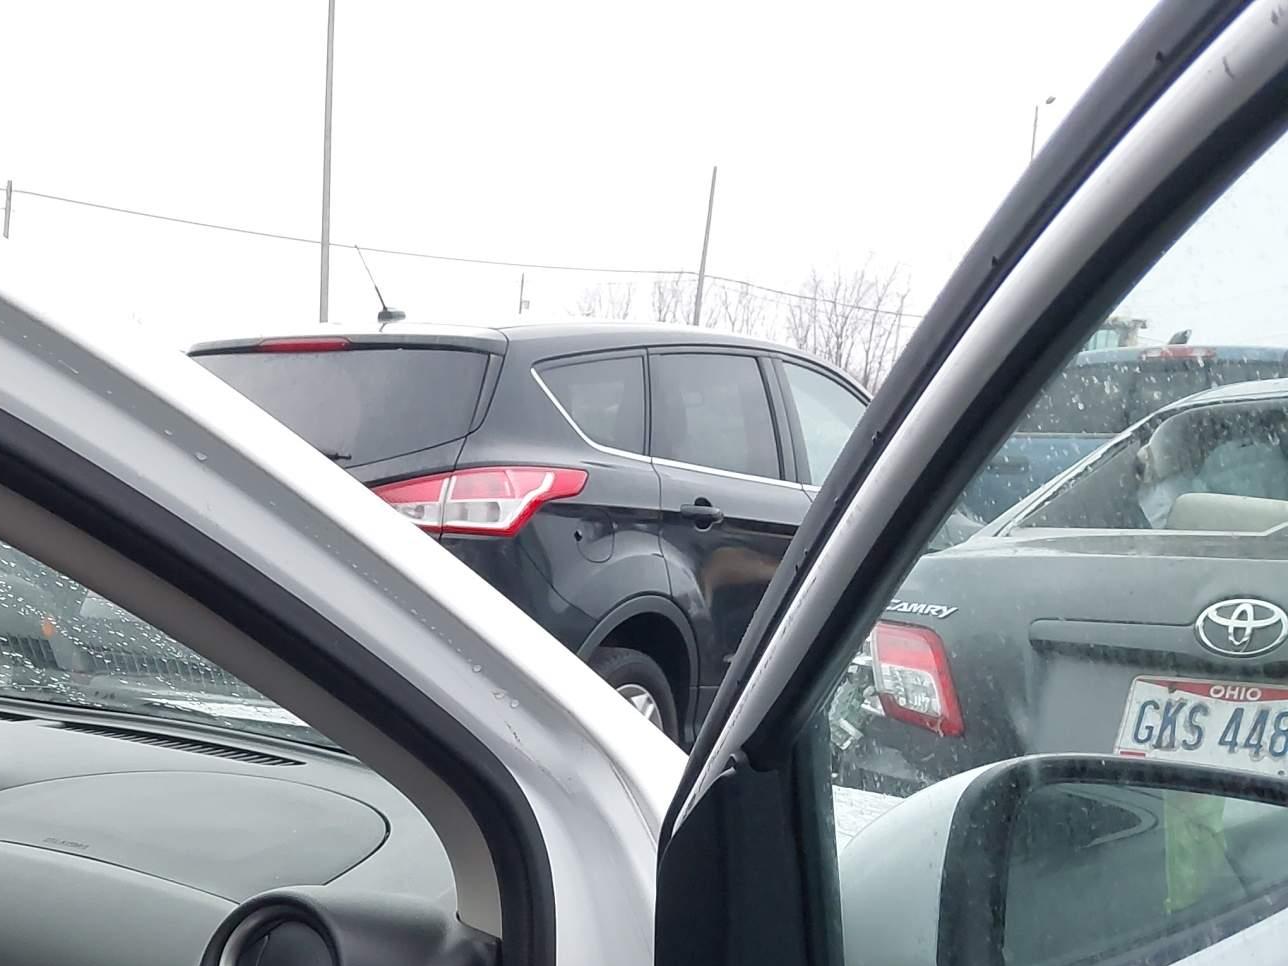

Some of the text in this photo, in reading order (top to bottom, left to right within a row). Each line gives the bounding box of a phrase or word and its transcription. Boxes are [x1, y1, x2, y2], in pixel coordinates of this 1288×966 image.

[1209, 685, 1262, 701] OHIO
[1133, 699, 1288, 757] GKS 448
